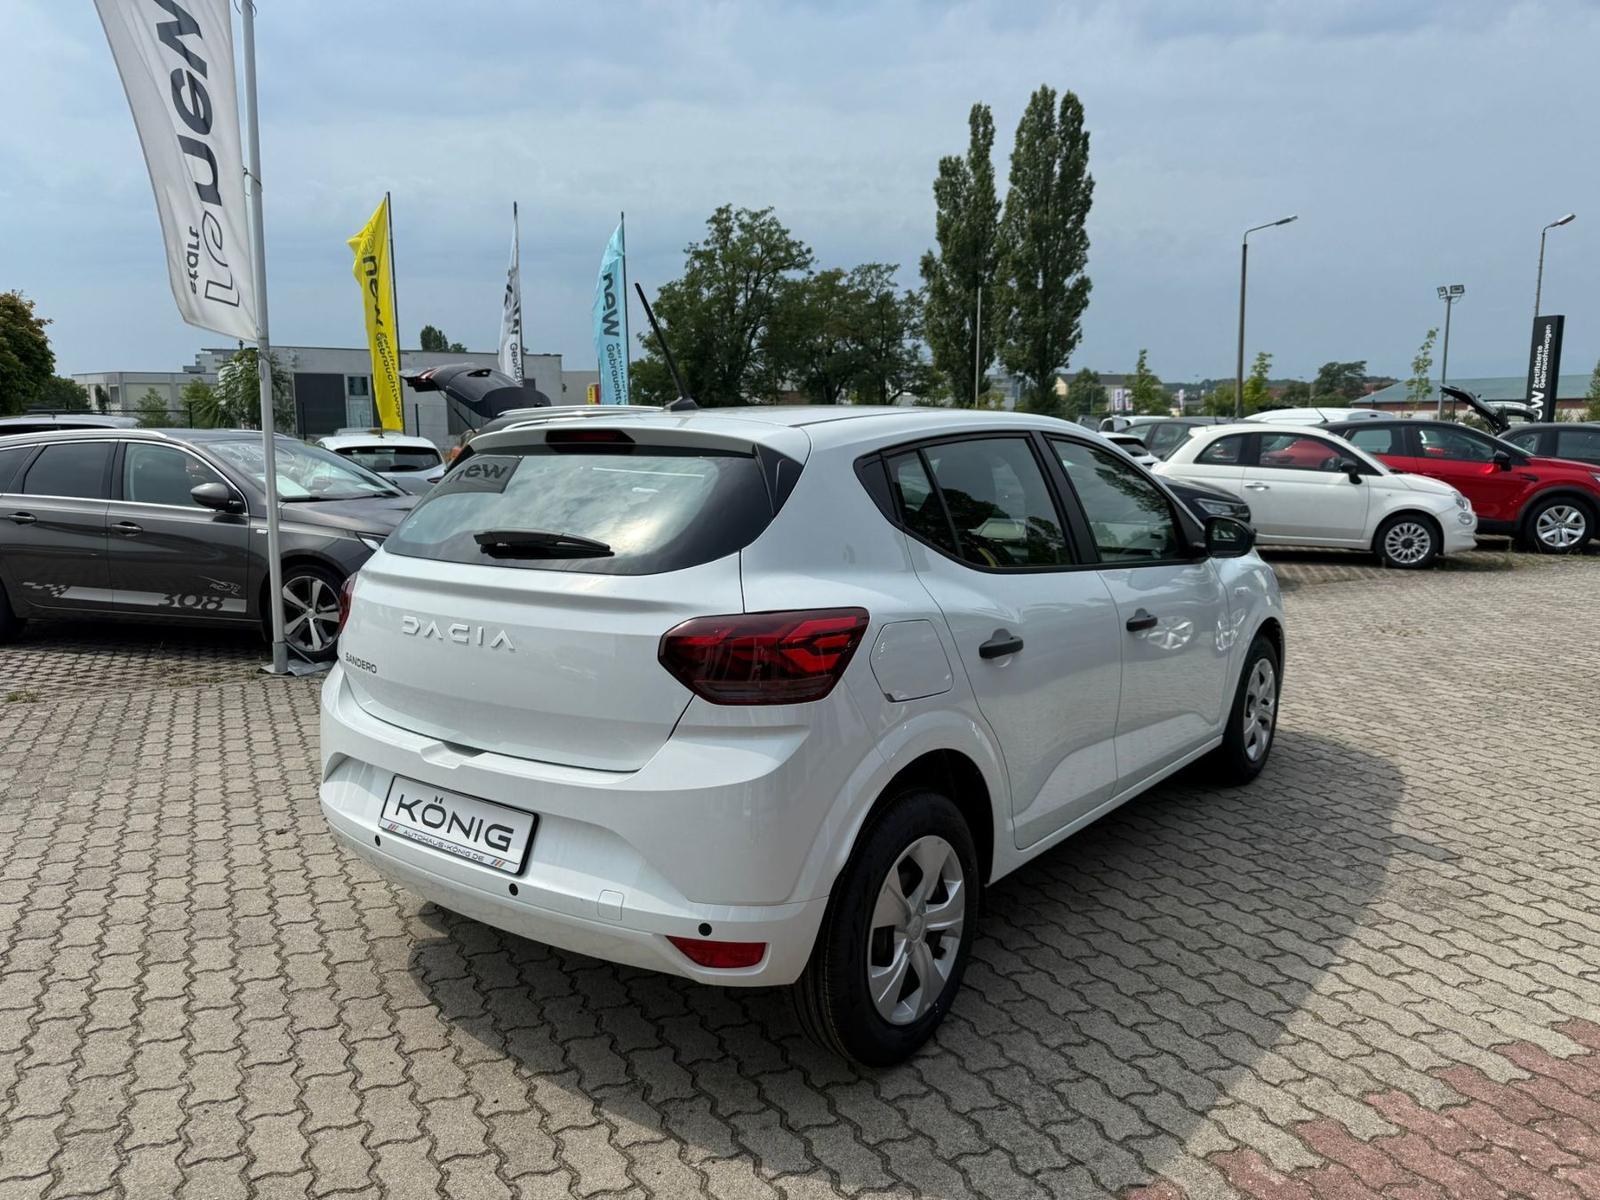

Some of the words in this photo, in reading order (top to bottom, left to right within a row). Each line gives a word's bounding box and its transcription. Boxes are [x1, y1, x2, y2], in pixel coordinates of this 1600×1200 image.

[602, 271, 620, 337] new
[1533, 345, 1543, 389] Zertifizierte
[1540, 324, 1552, 389] Gebrauchtwagen
[159, 591, 224, 612] 308
[401, 615, 516, 652] DACIA
[345, 651, 378, 675] SANDERO
[395, 794, 515, 853] KÖNIG
